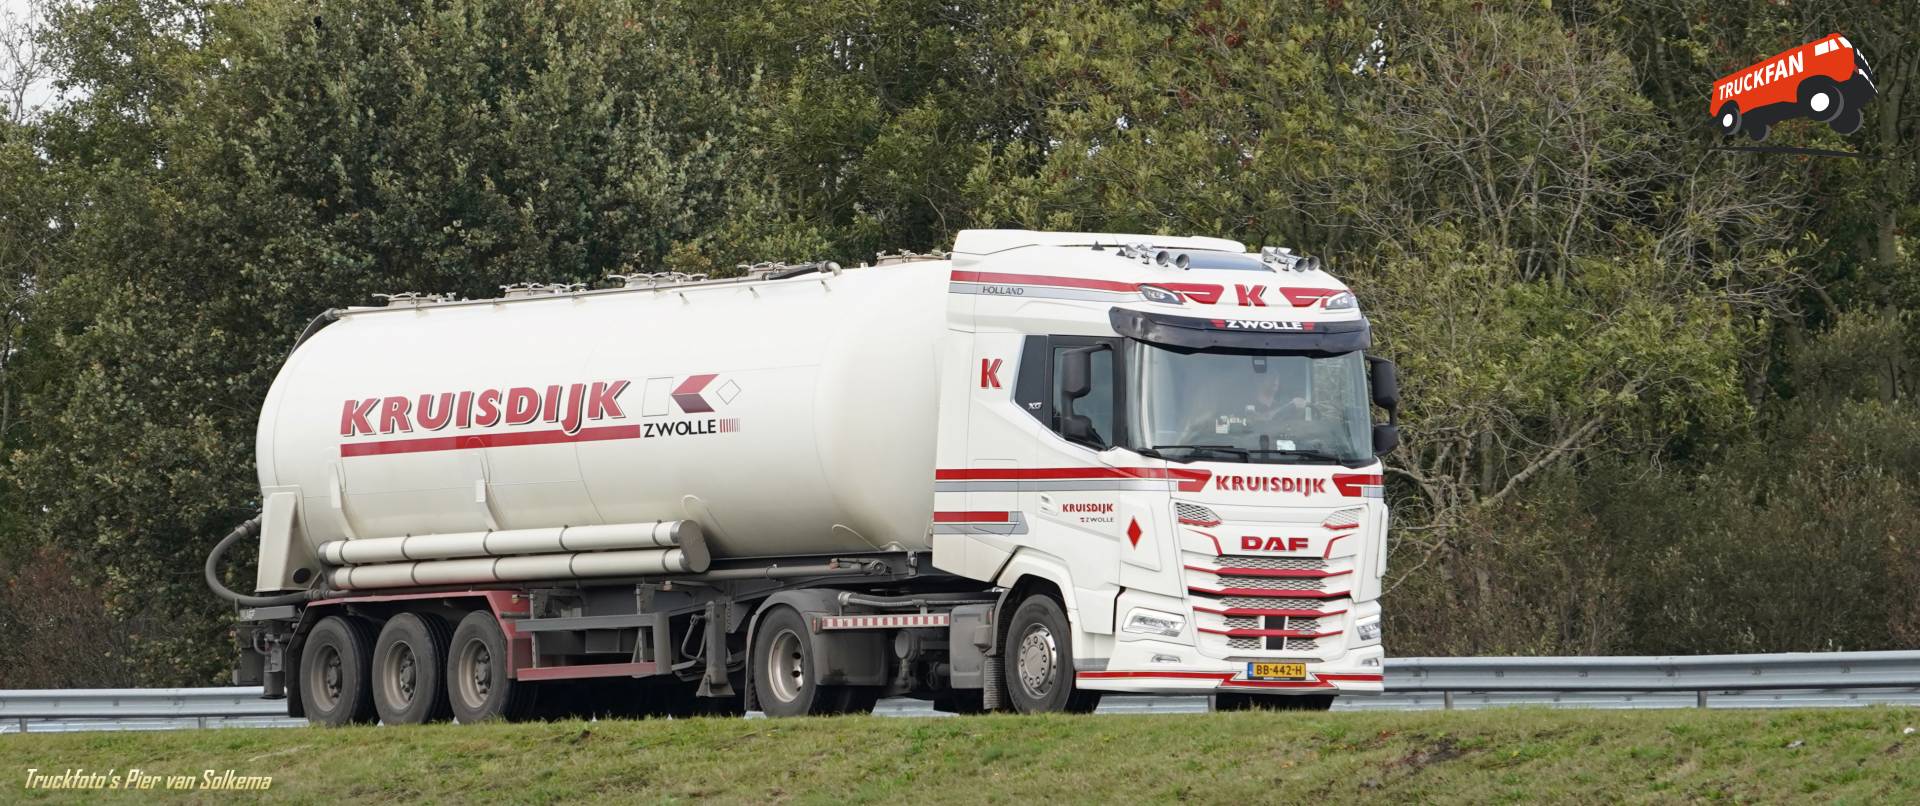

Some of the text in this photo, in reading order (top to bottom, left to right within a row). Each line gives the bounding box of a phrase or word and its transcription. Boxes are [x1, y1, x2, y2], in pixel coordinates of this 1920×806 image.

[983, 286, 1024, 296] HOLLAND
[1234, 284, 1267, 307] K
[1226, 320, 1303, 330] ZWOLLE
[981, 358, 1003, 389] K
[339, 379, 631, 437] KRUISDIJK
[643, 419, 717, 439] ZWOLLE
[1215, 474, 1327, 497] KRUISDIJK
[1062, 503, 1113, 514] KRUISDIJK
[1240, 535, 1309, 551] DAF
[1256, 664, 1302, 676] BB-442-H
